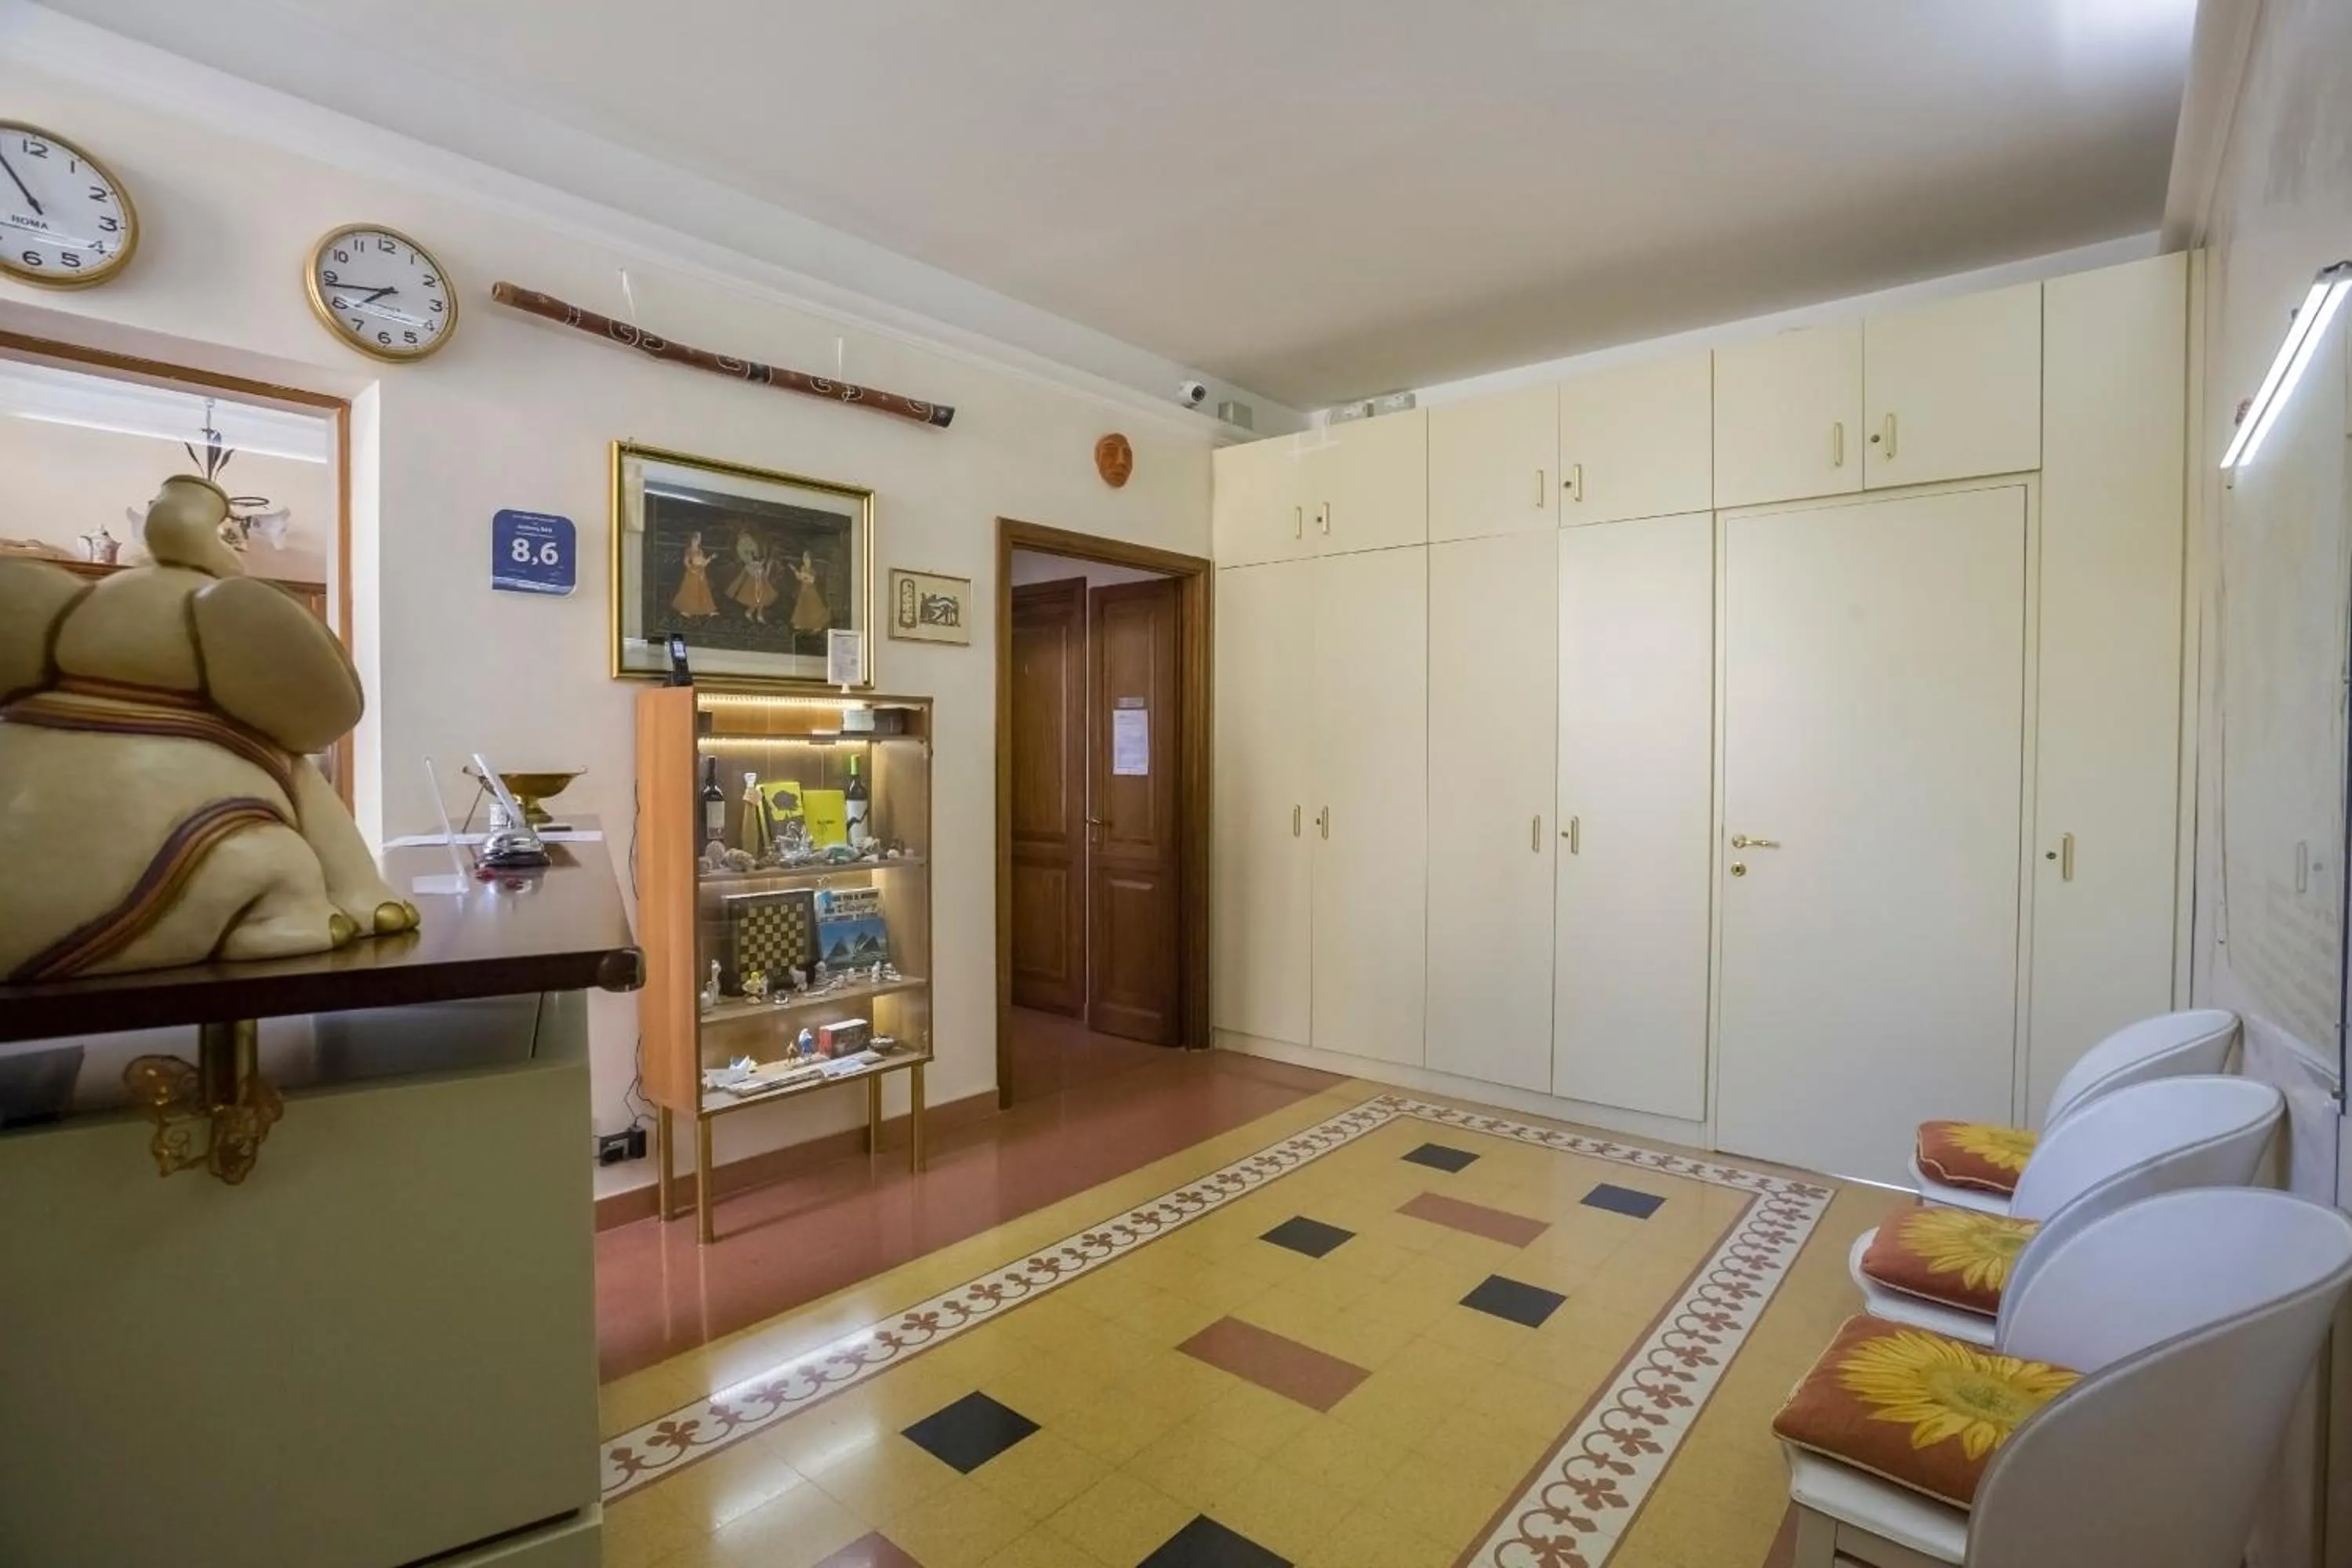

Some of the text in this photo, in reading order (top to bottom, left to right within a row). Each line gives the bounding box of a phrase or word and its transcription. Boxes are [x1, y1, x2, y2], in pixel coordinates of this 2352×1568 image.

[24, 138, 49, 158] 12
[71, 160, 75, 173] 1
[89, 186, 107, 203] 2
[12, 214, 49, 230] ROMA
[99, 216, 118, 232] 3
[88, 240, 106, 255] 4
[354, 239, 365, 252] 11
[378, 238, 396, 255] 12
[23, 250, 42, 267] 6
[60, 252, 81, 267] 5
[333, 249, 349, 263] 10
[410, 254, 415, 265] 1
[323, 270, 338, 285] 9
[423, 274, 436, 288] 2
[429, 299, 443, 313] 3
[351, 318, 365, 332] 7
[377, 332, 392, 344] 6
[404, 330, 418, 344] 5
[511, 537, 558, 565] 8,6
